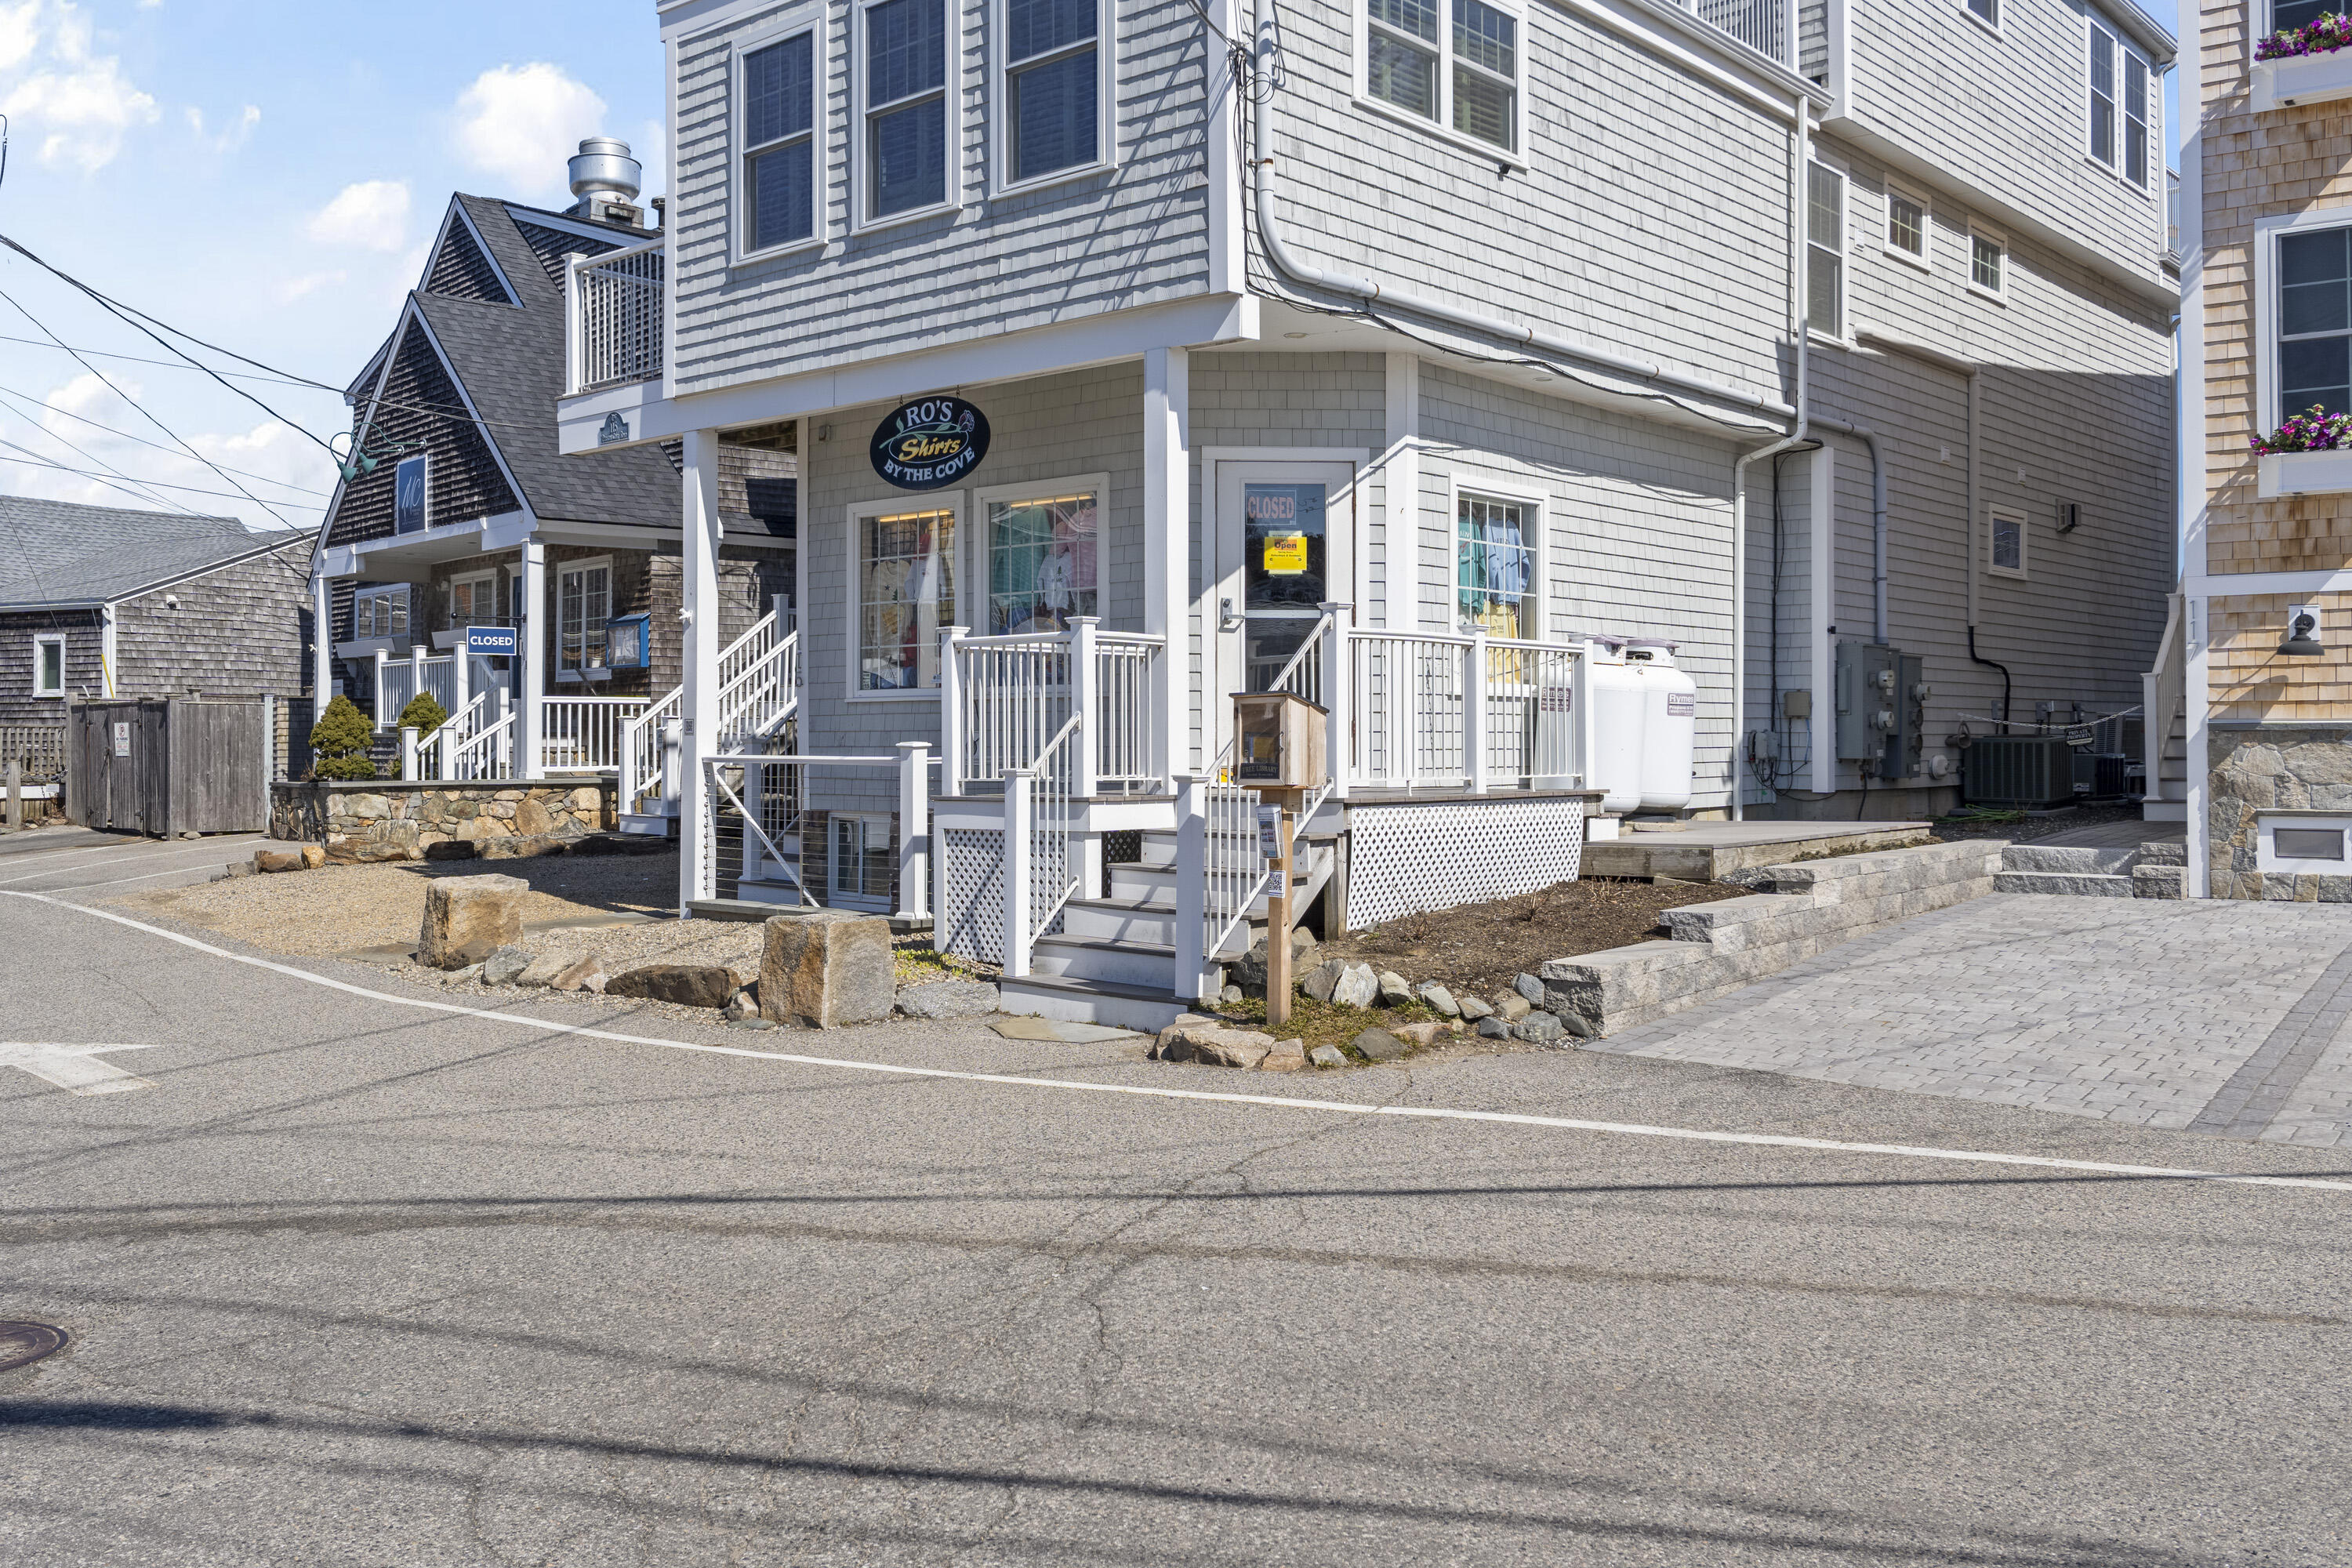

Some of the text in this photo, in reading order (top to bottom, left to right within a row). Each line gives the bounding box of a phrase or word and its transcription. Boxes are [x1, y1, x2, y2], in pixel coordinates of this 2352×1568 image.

[906, 399, 953, 427] RO'S
[898, 437, 961, 463] Shirts
[884, 446, 976, 481] BY THE COVE
[1247, 495, 1295, 520] CLOSED
[1274, 542, 1298, 550] Open
[470, 635, 514, 647] CLOSED
[1669, 694, 1694, 703] Rymes
[1242, 764, 1277, 774] FREE LIBRARY
